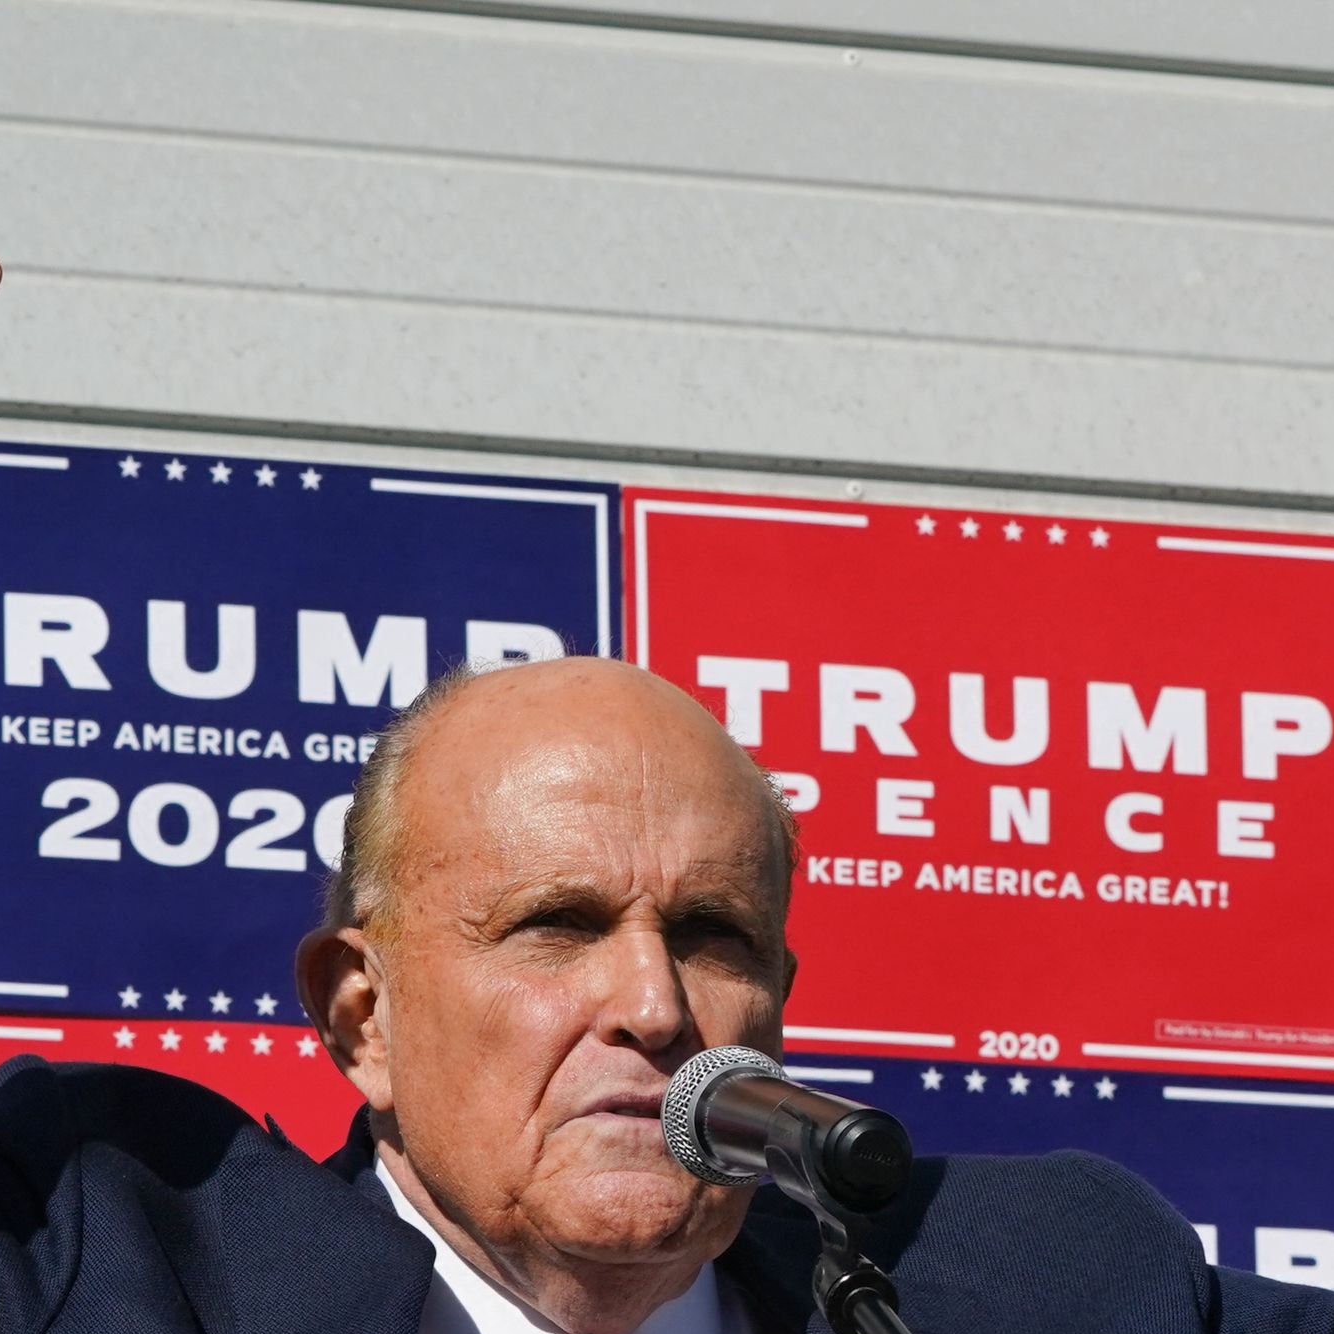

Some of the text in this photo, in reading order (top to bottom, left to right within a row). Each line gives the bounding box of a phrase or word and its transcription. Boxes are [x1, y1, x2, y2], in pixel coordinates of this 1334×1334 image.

[1, 715, 378, 765] KEEP AMERICA GRE
[697, 655, 1333, 780] TRUMP
[807, 856, 1229, 909] KEEP AMERICA GREAT!
[978, 1030, 1060, 1061] 2020
